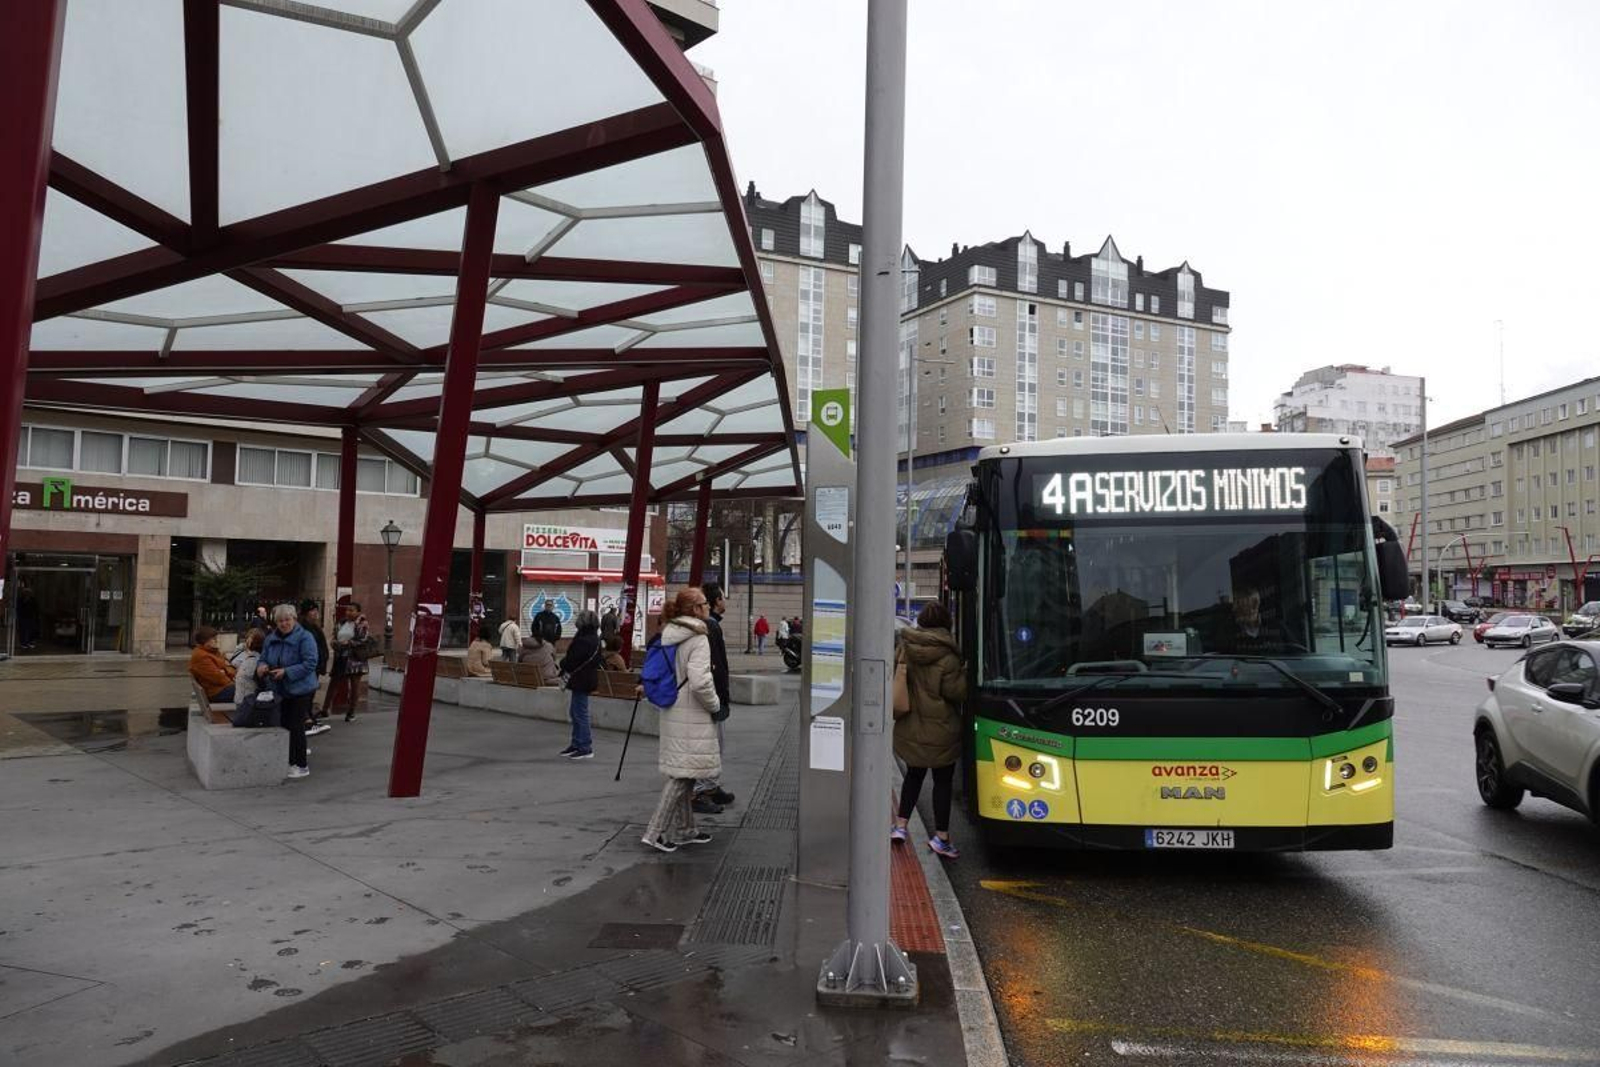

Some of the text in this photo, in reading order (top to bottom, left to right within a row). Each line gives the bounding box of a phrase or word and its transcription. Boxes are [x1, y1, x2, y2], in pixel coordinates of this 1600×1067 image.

[1042, 467, 1307, 514] 4A SERVIZOS MINIMOS
[1072, 708, 1120, 726] 6209
[1151, 765, 1220, 777] avanza
[1160, 786, 1226, 800] MAN
[1156, 831, 1232, 847] 6242 JKH
